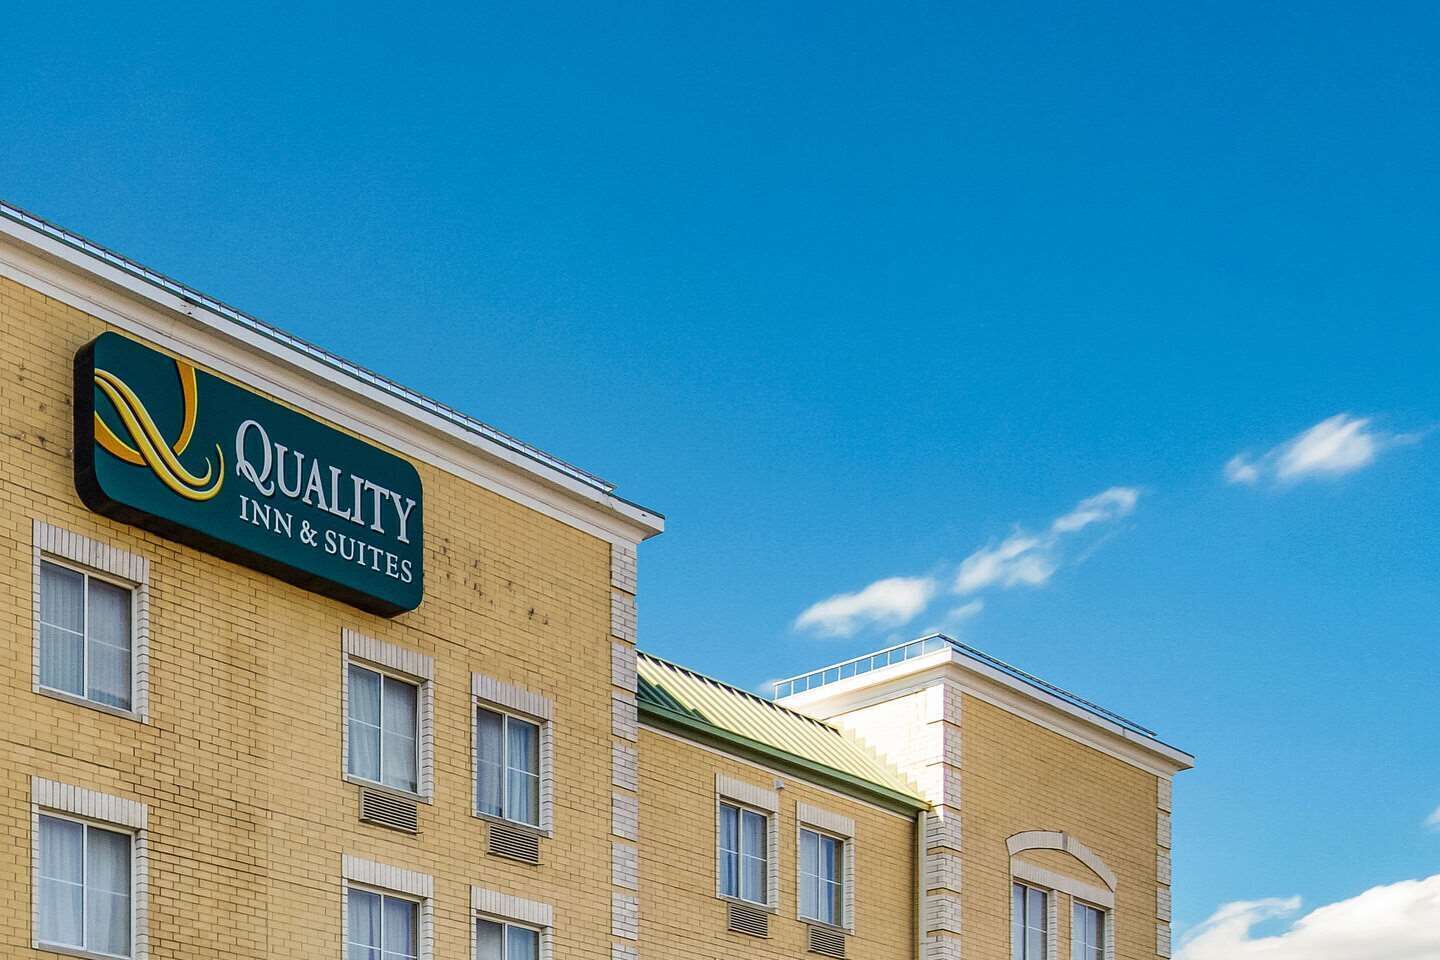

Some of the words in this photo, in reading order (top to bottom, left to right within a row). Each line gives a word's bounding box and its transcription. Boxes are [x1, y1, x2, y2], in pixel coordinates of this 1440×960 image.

[235, 419, 416, 544] QUALITY
[239, 494, 293, 538] INN
[299, 519, 318, 547] &
[324, 529, 412, 583] SUITES
